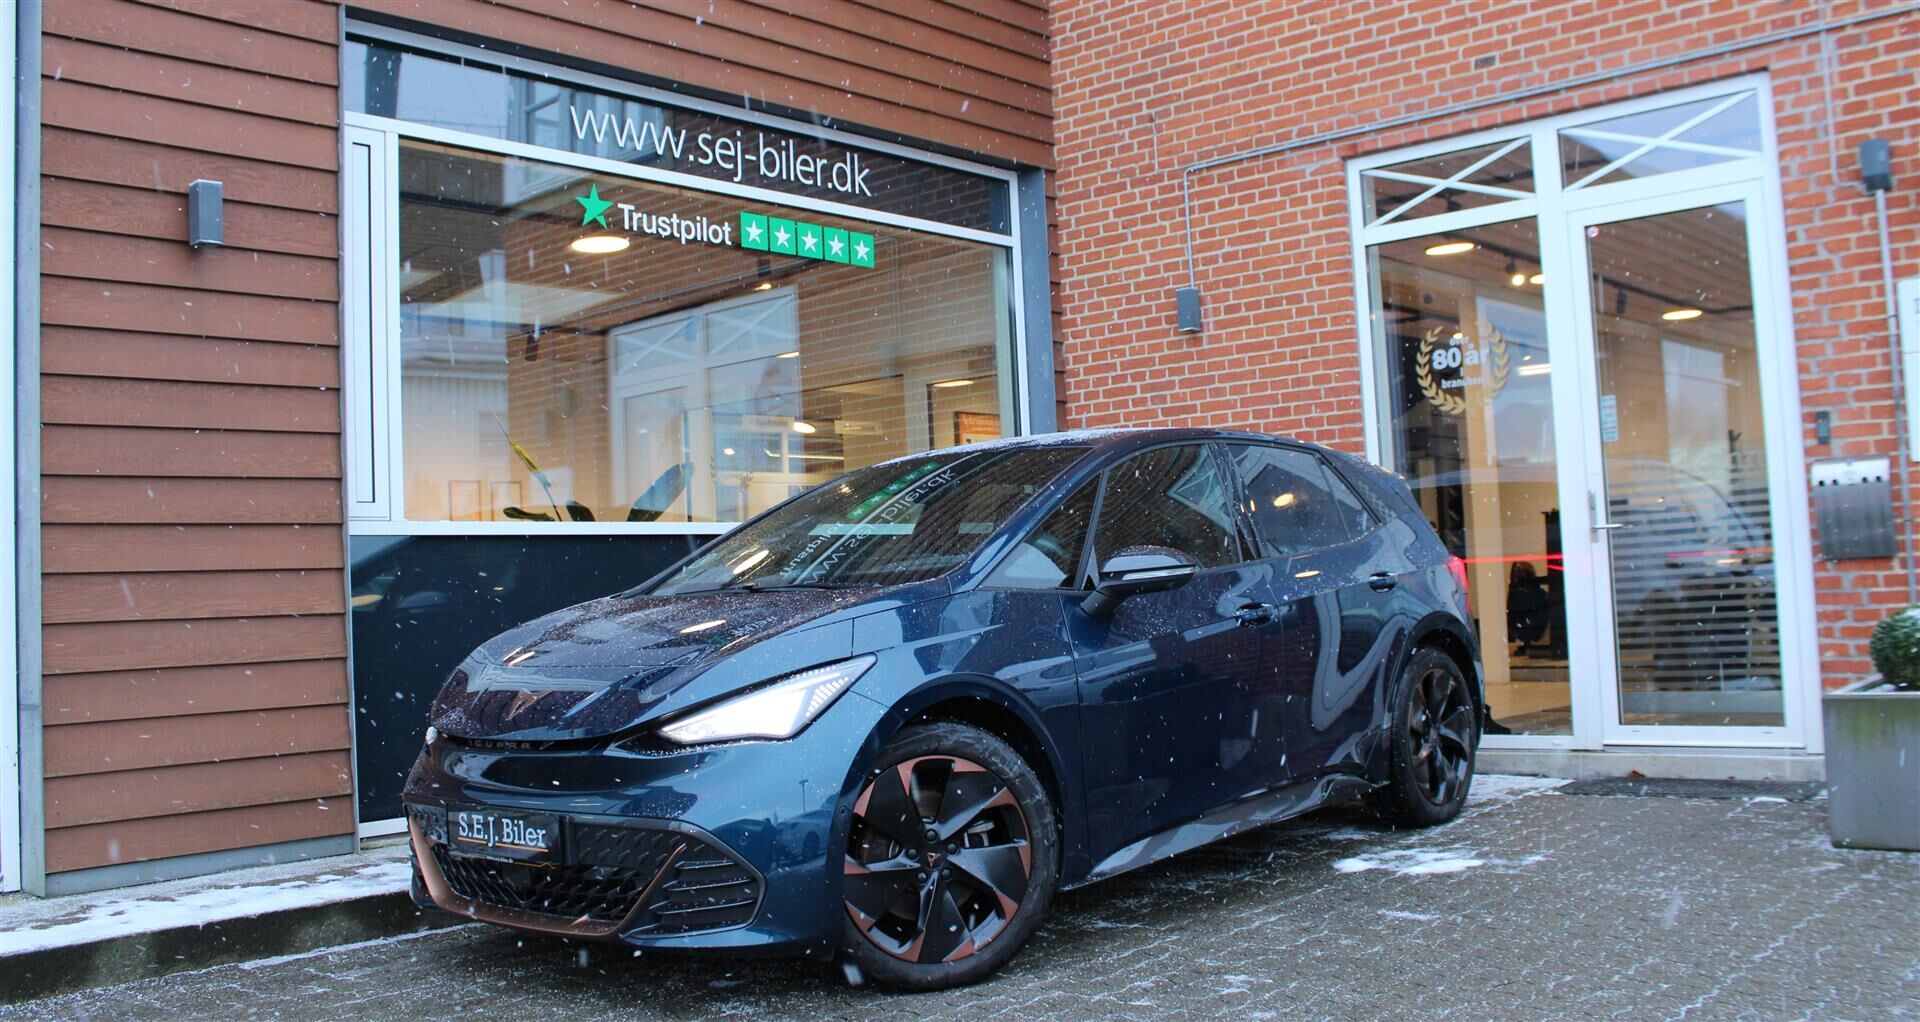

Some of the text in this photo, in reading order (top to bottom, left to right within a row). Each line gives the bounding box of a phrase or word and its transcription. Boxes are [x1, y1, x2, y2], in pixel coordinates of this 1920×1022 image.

[570, 105, 873, 197] www.sej-biler.dk
[617, 203, 732, 246] Trustpilot
[1432, 343, 1489, 370] 80 år
[458, 812, 546, 848] S.E.J. Biler
